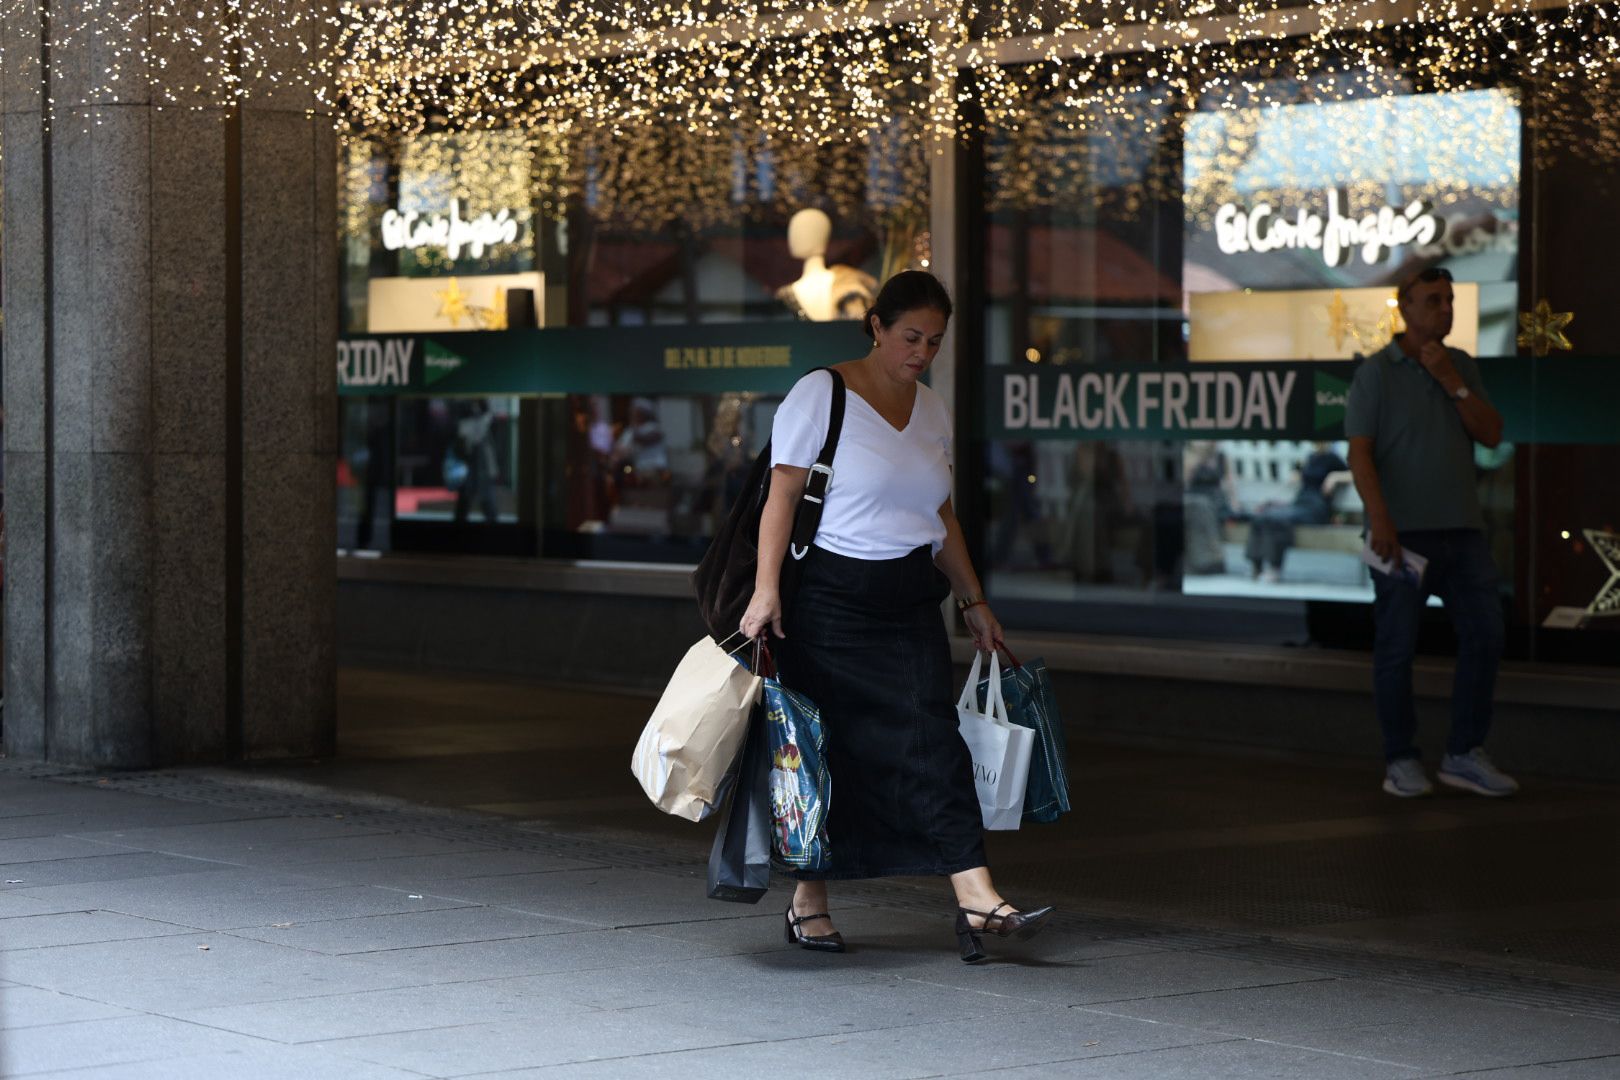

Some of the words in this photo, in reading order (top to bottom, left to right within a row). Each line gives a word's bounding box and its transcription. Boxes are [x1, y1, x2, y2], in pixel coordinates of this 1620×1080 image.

[1215, 203, 1249, 254] El
[1248, 203, 1322, 253] Corte
[1322, 187, 1437, 267] Inglés
[336, 338, 415, 386] RIDAY
[1003, 372, 1131, 430] BLACK
[1136, 370, 1297, 430] FRIDAY
[973, 762, 997, 786] INO
